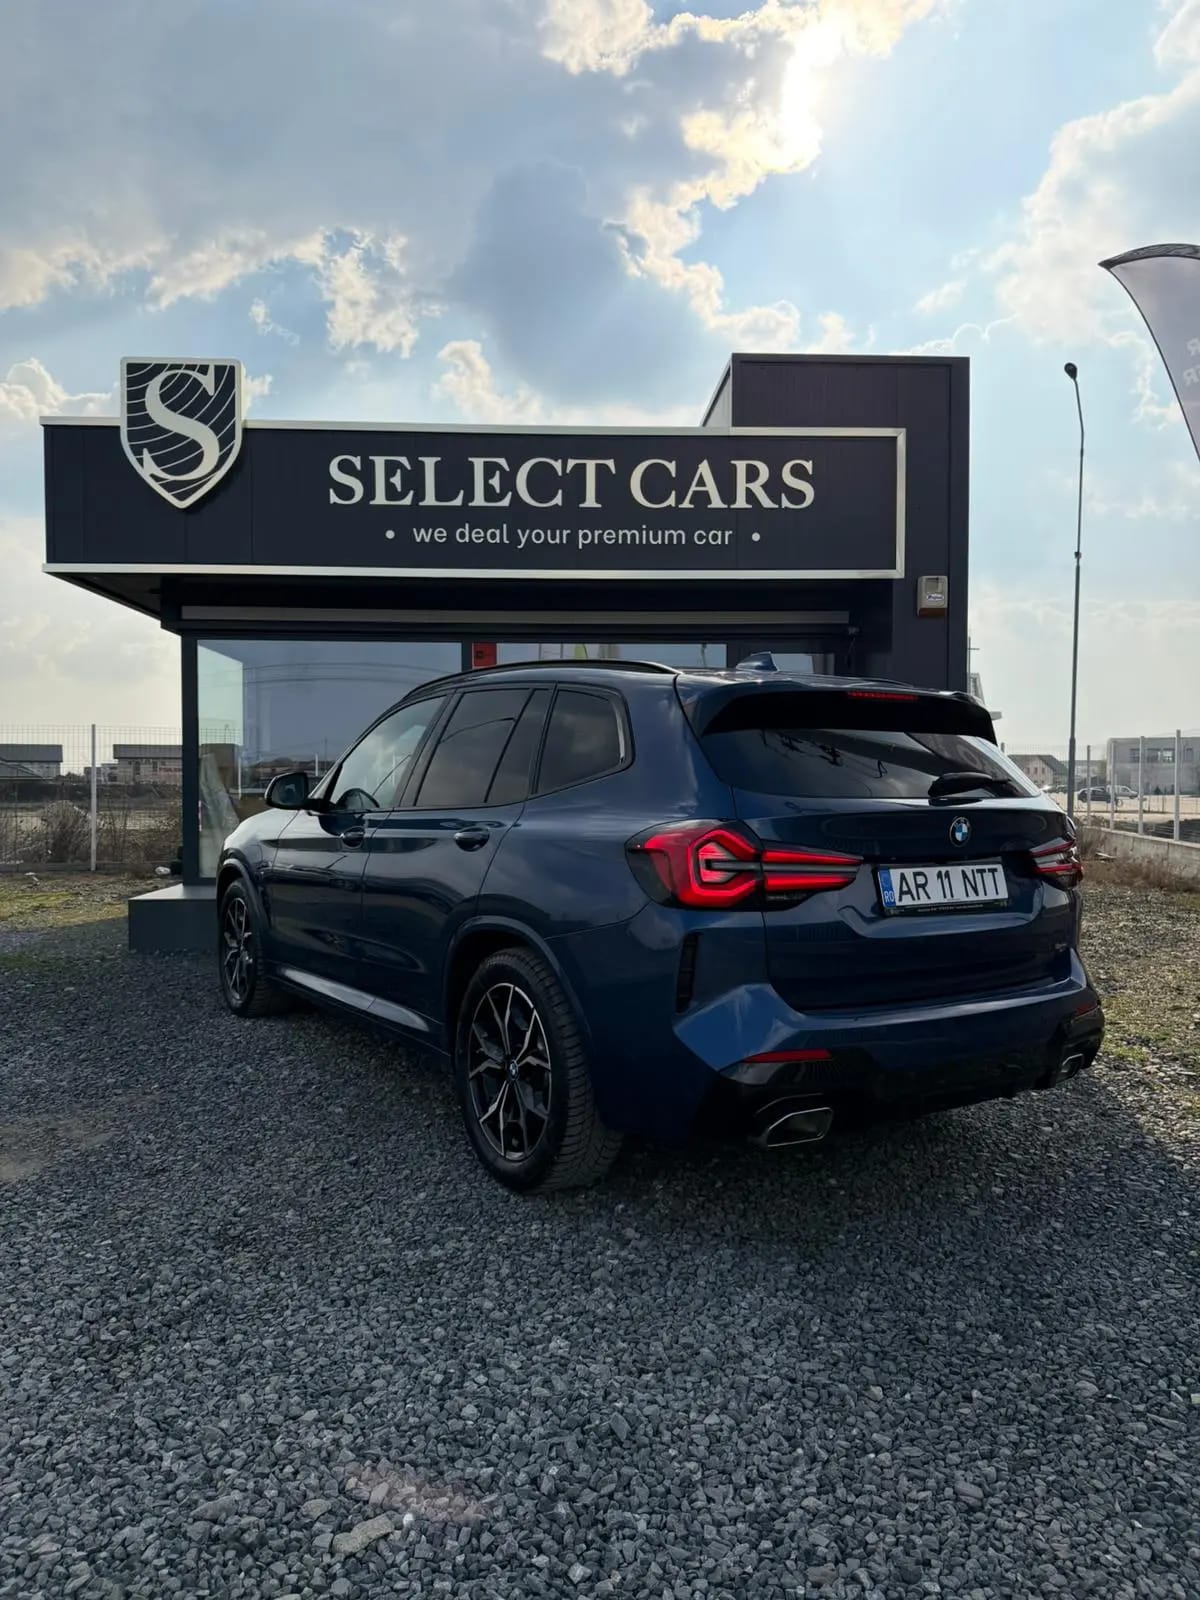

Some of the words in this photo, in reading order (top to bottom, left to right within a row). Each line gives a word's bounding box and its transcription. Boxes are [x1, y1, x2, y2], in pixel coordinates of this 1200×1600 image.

[144, 364, 220, 481] S
[329, 455, 616, 508] SELECT
[630, 459, 815, 509] CARS
[412, 527, 448, 543] we
[455, 523, 510, 544] deal
[517, 528, 571, 549] your
[578, 525, 686, 550] premium
[693, 529, 733, 545] car
[898, 871, 931, 903] AR
[936, 869, 954, 899] 11
[961, 867, 999, 898] NTT
